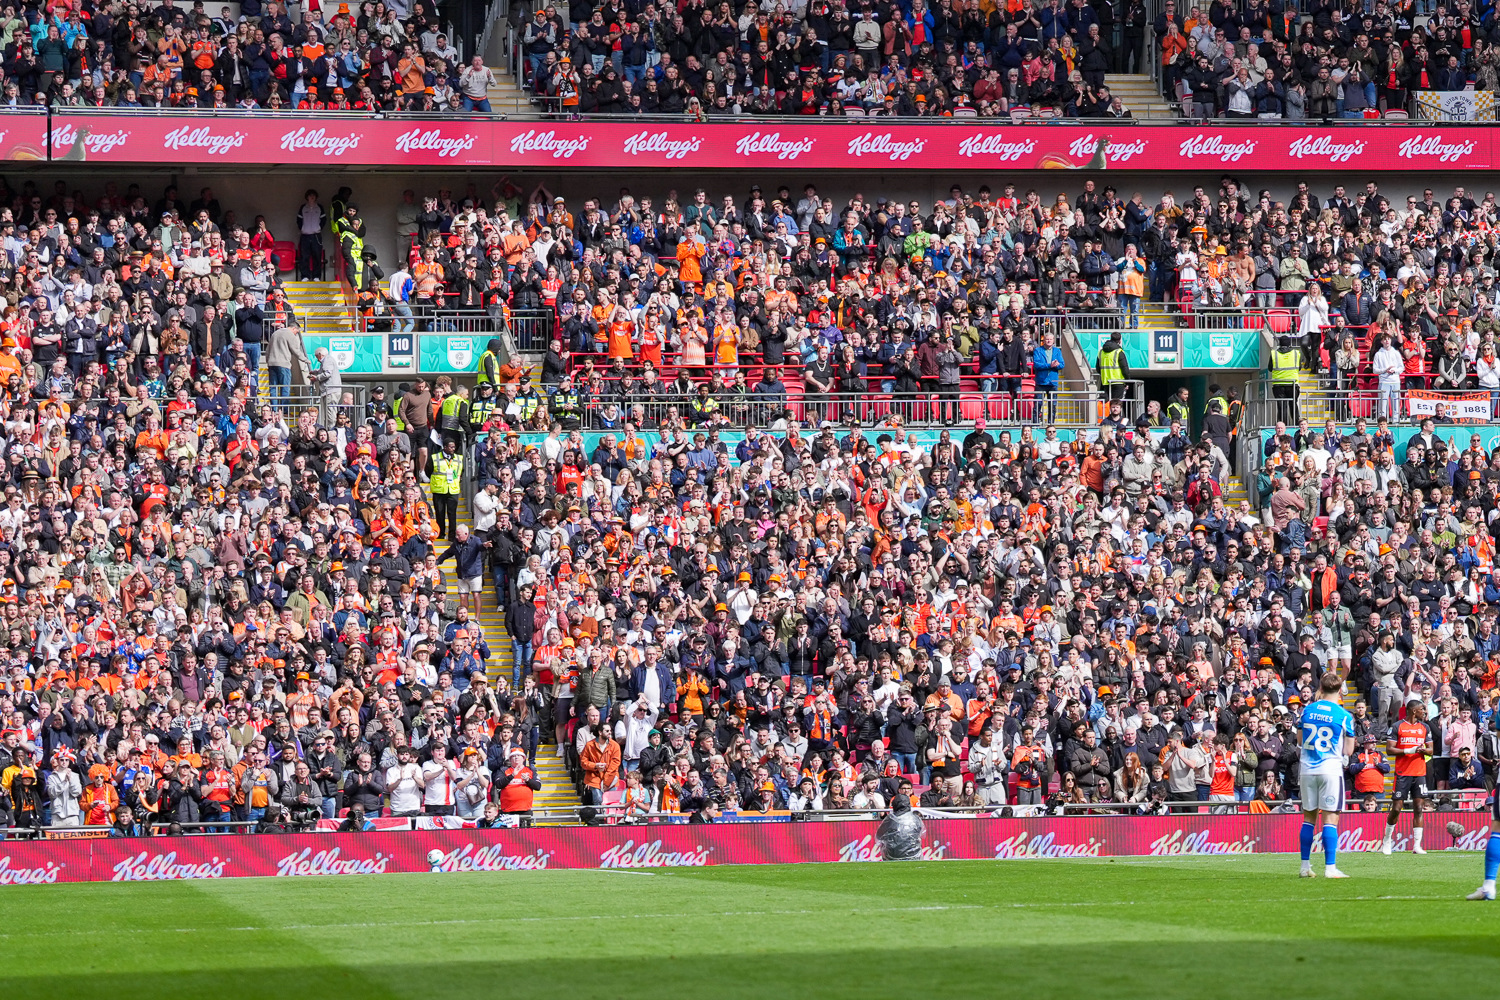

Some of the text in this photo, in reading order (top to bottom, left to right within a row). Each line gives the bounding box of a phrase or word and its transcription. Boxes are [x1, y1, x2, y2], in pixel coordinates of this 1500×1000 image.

[1445, 95, 1472, 107] LUTON TOWN
[164, 126, 245, 155] Kellogg's
[281, 127, 360, 156] Kellogg's
[396, 129, 475, 157] Kellogg's
[511, 130, 588, 158] Kellogg's
[624, 131, 701, 159] Kellogg's
[736, 132, 813, 160] Kellogg's
[848, 133, 924, 161] Kellogg's
[959, 134, 1035, 161] Kellogg's
[1180, 135, 1255, 161] Kellogg's
[1289, 135, 1364, 161] Kellogg's
[1399, 135, 1474, 161] Kellogg's
[391, 338, 409, 350] 110
[1159, 335, 1173, 348] 111
[1411, 391, 1488, 401] LUTON TOWN
[1417, 403, 1433, 411] EST
[1309, 713, 1333, 723] STOKES
[1303, 723, 1334, 752] 28
